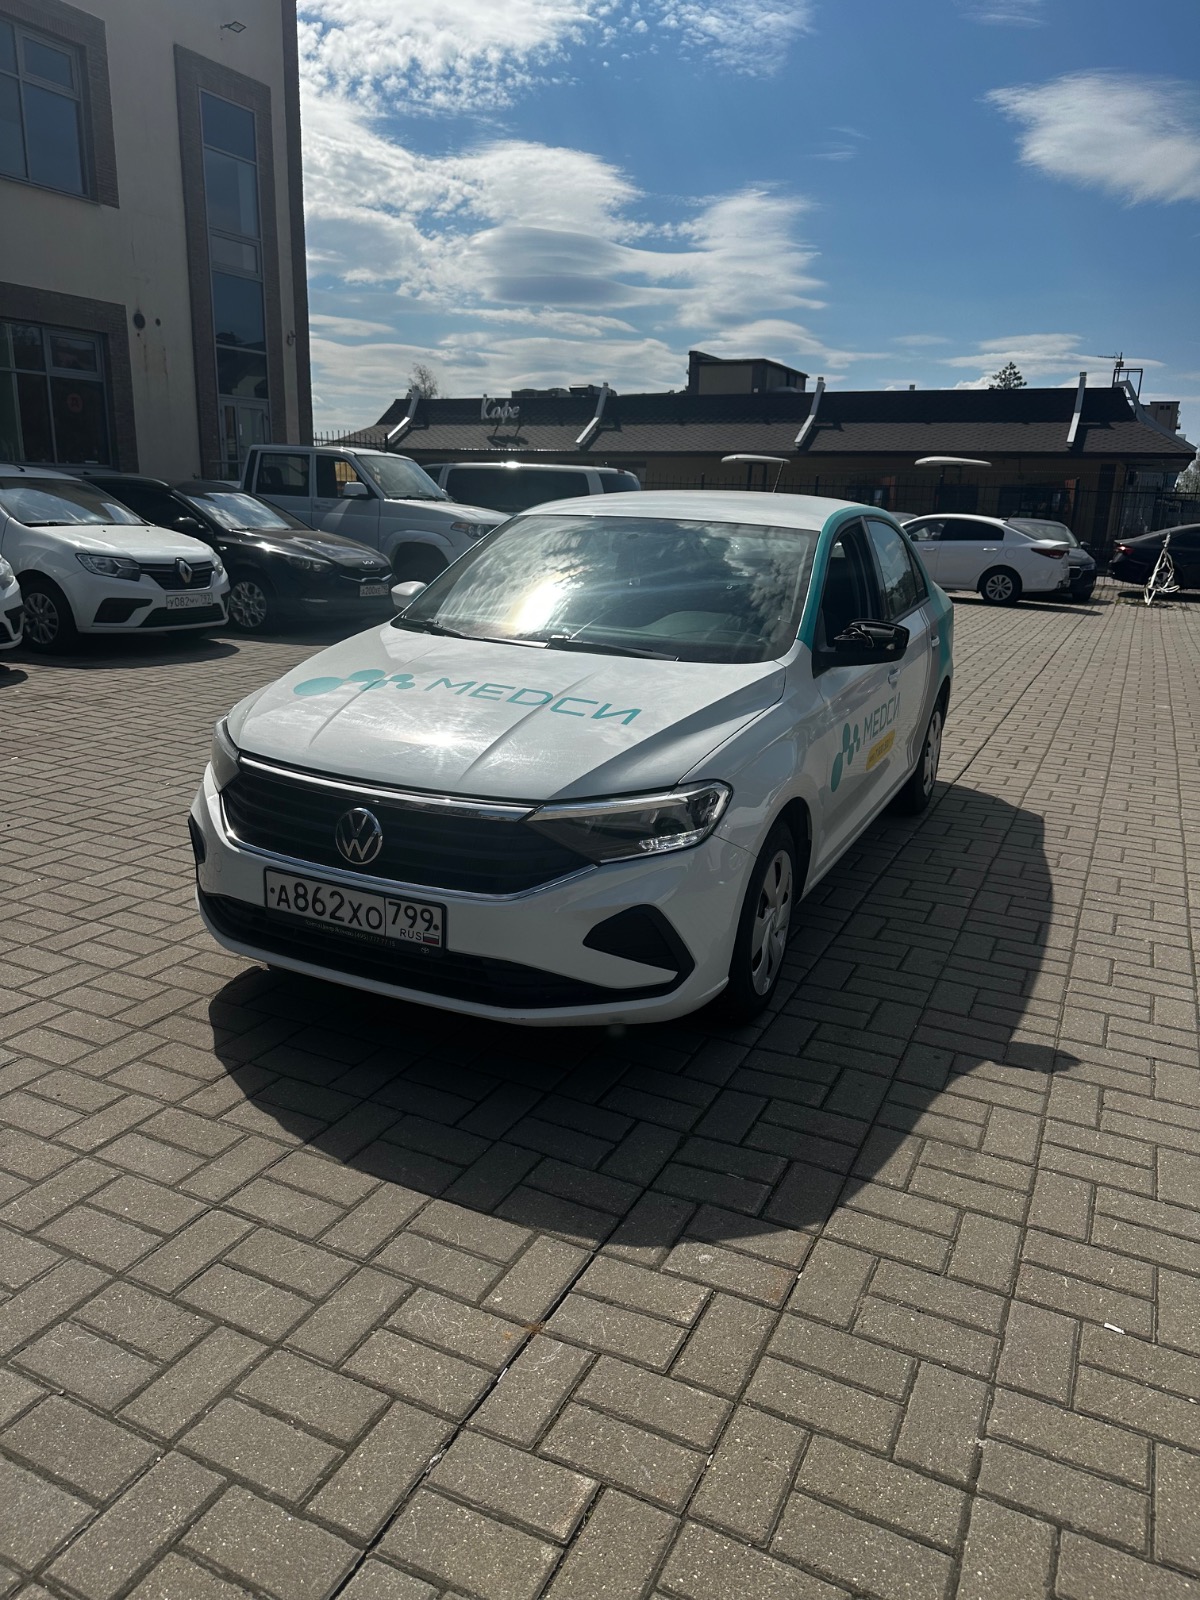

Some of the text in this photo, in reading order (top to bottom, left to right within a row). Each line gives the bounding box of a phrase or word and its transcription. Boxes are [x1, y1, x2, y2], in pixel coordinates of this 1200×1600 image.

[480, 397, 520, 424] Кафе
[276, 882, 383, 930] А862ХО
[388, 901, 434, 932] 799
[400, 928, 422, 942] RUS
